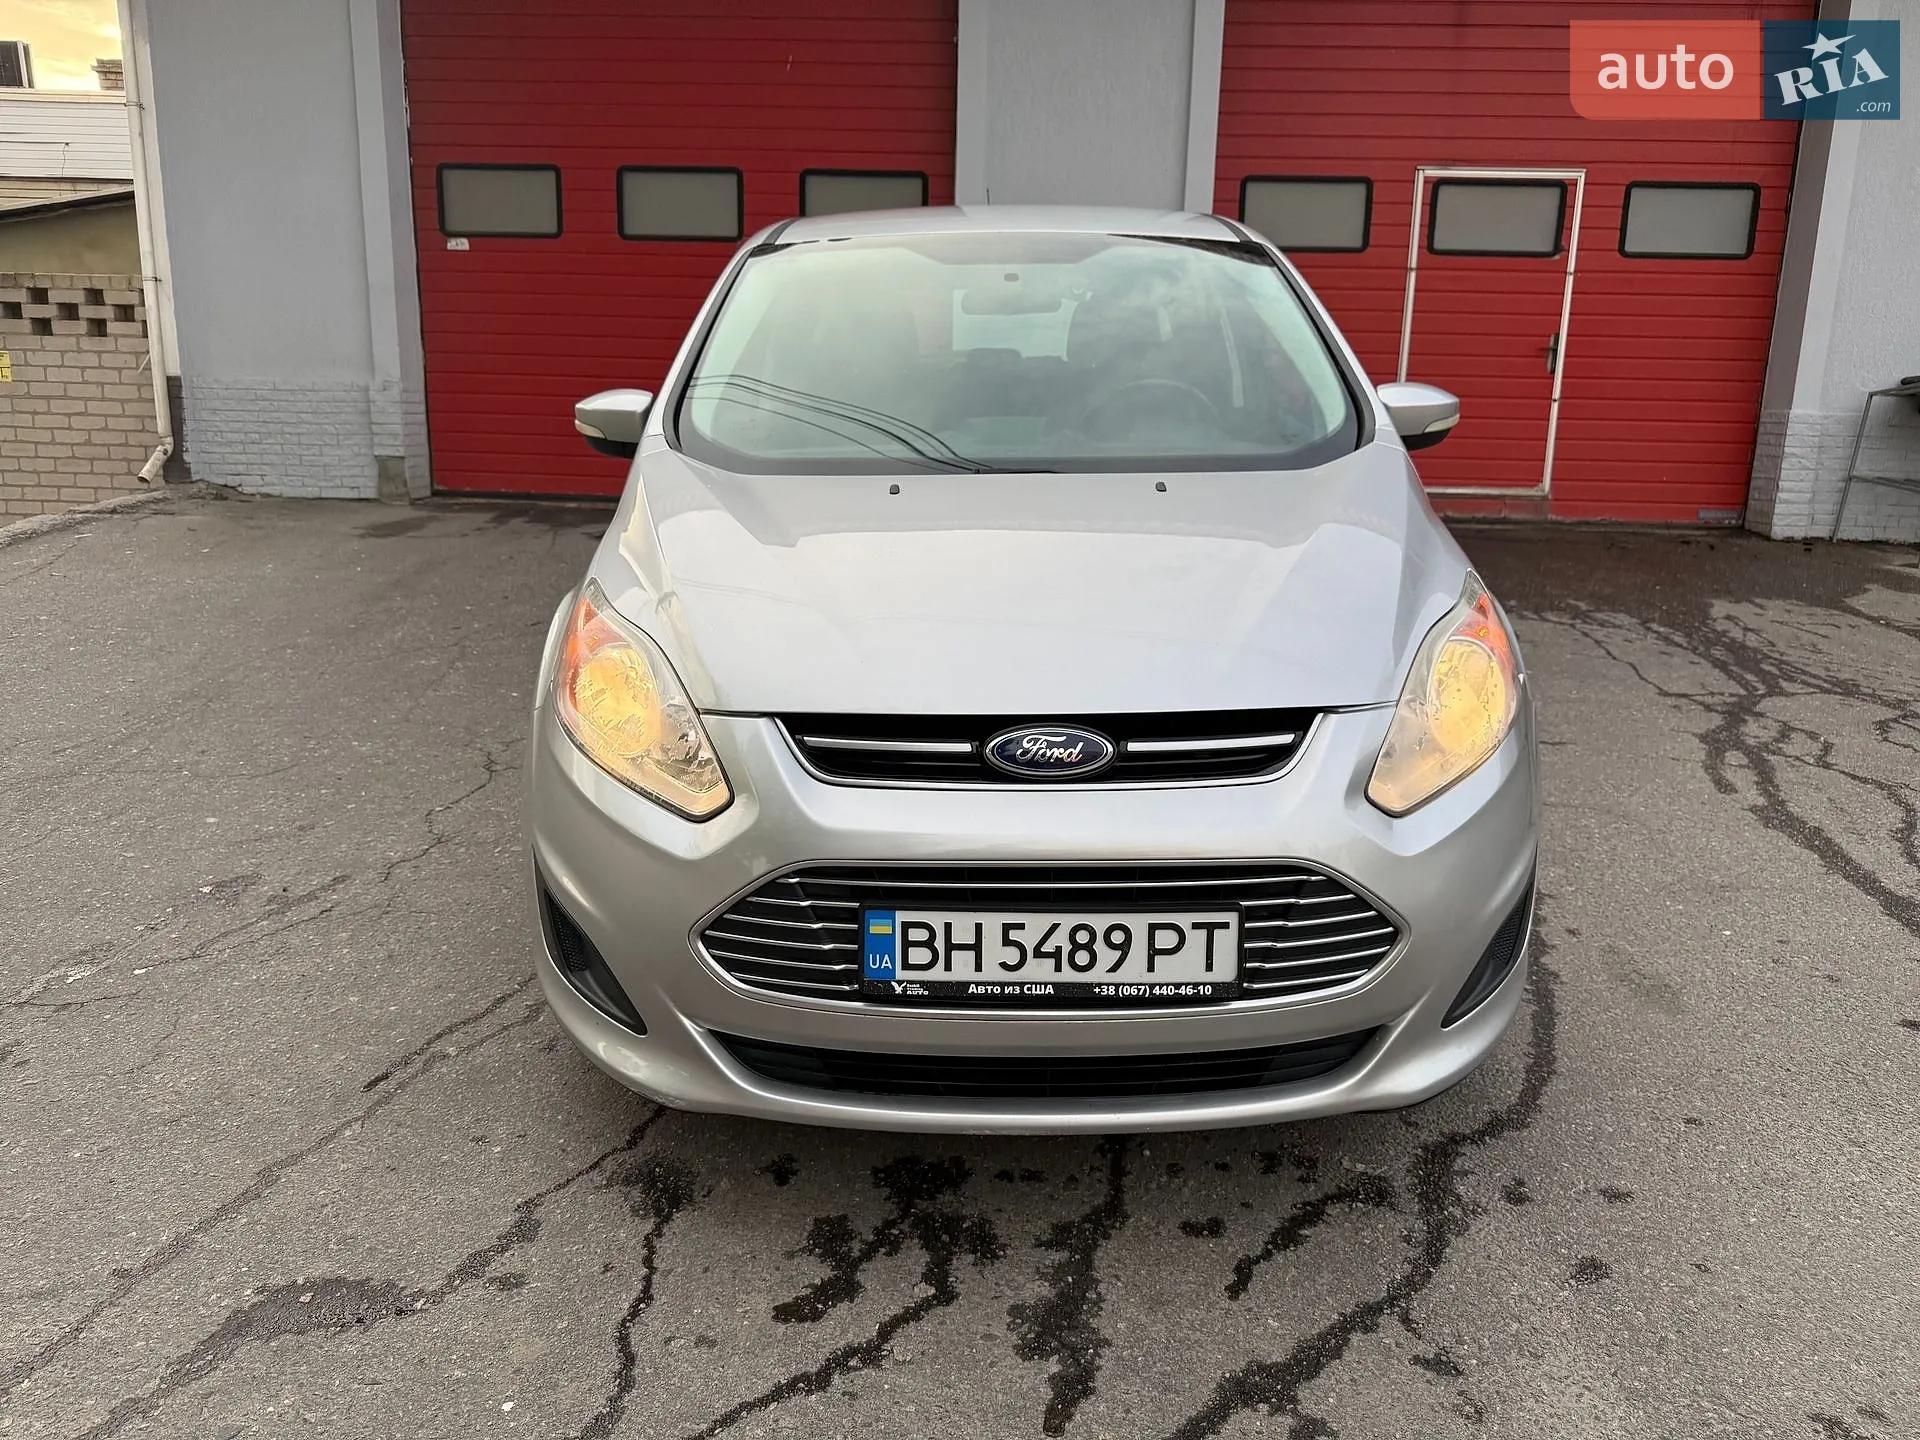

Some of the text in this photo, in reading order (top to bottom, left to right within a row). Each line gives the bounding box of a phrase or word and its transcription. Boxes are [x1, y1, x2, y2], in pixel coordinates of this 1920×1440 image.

[1016, 735, 1084, 762] Ford
[900, 921, 1230, 973] BH 5489 PT
[869, 954, 892, 969] UA
[968, 983, 1054, 995] Авто из США
[1093, 984, 1212, 998] +38 (067) 440-46-10
